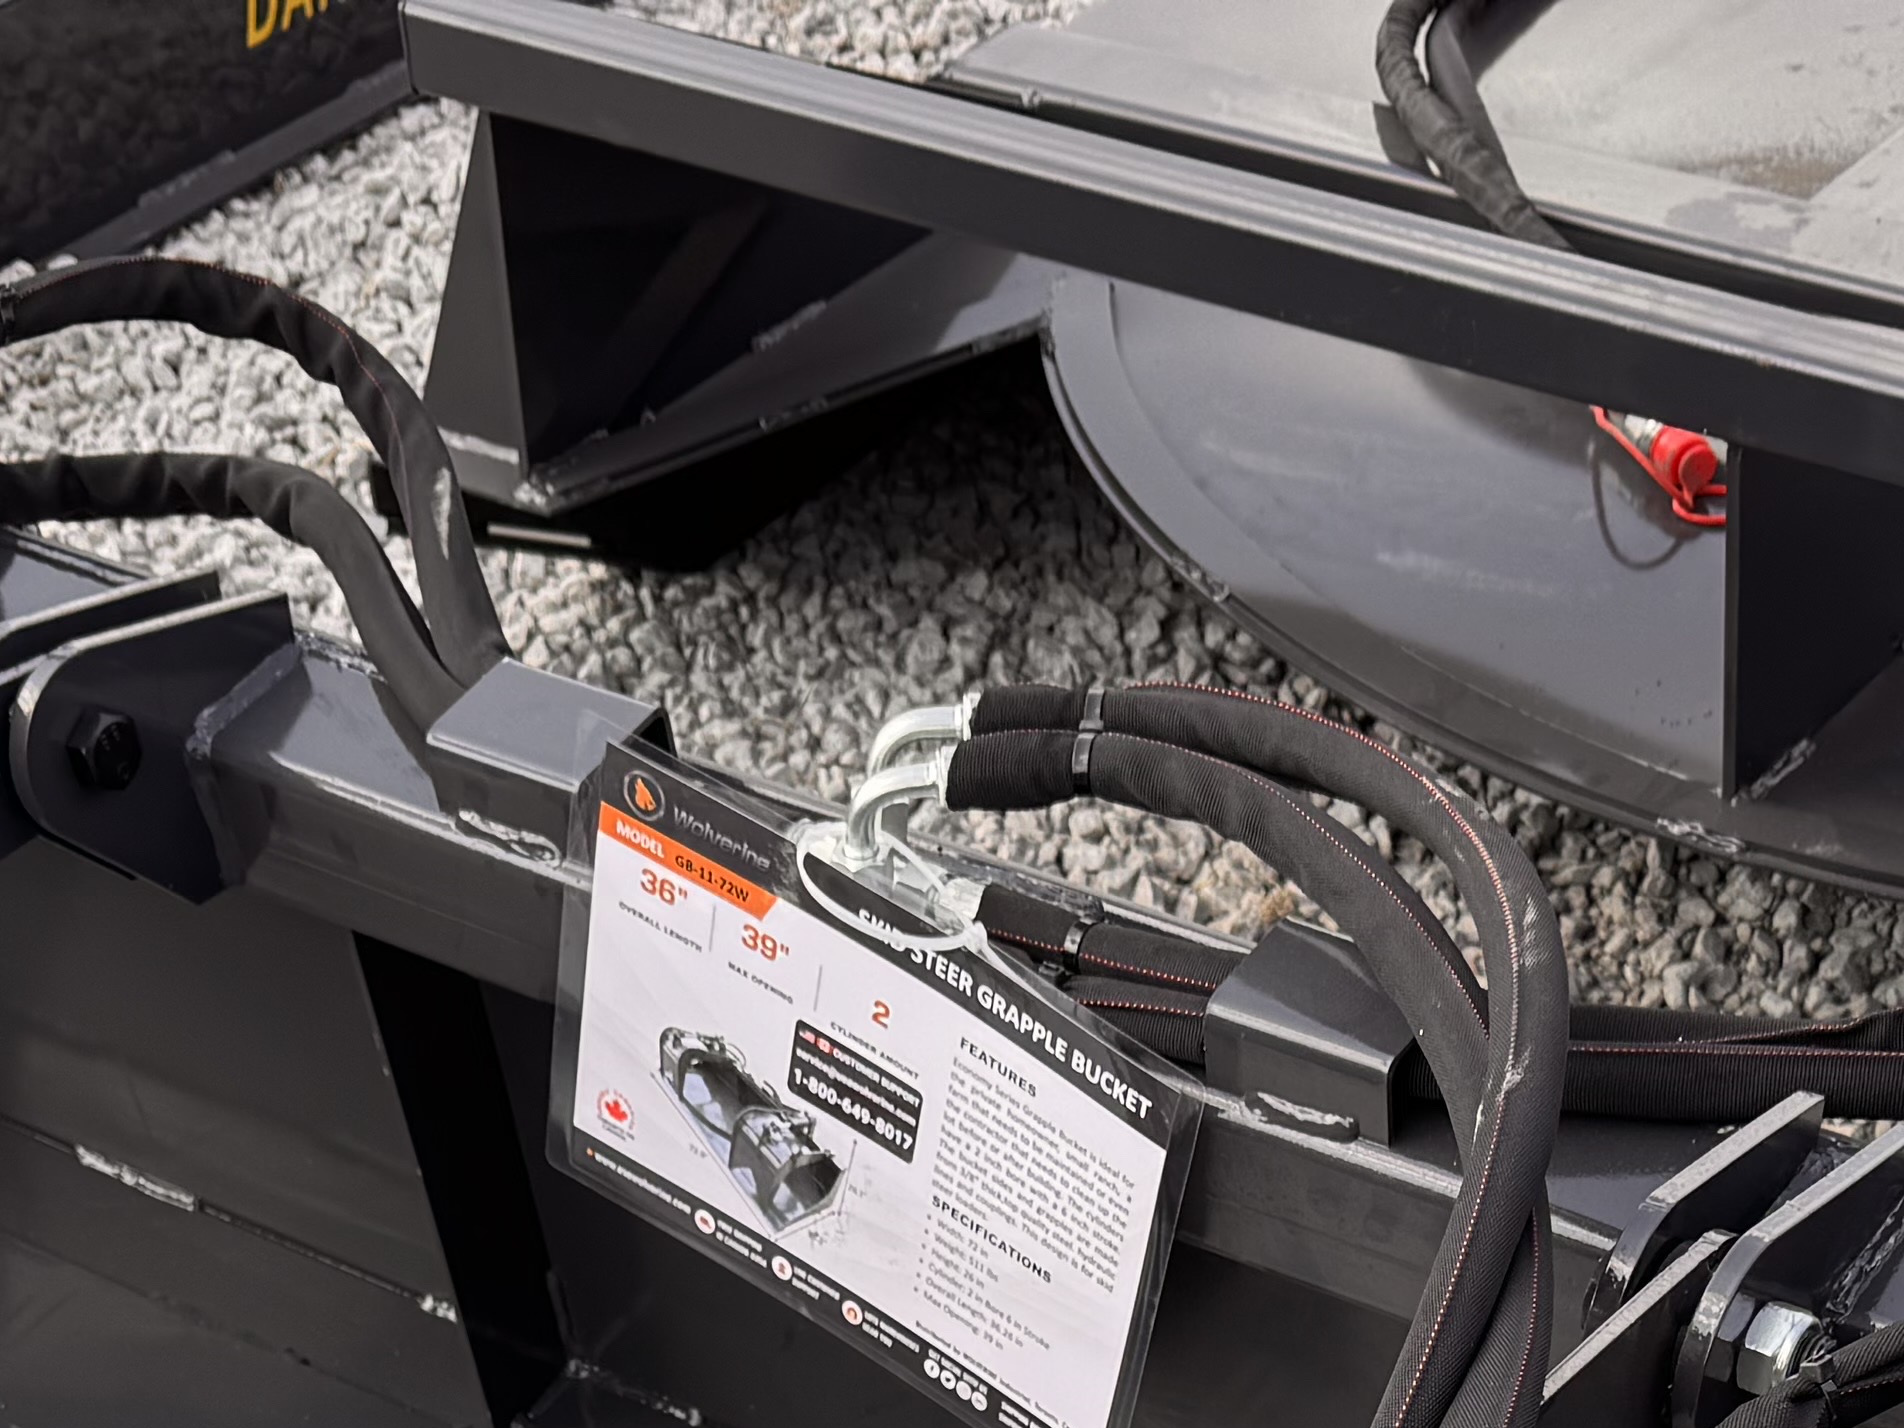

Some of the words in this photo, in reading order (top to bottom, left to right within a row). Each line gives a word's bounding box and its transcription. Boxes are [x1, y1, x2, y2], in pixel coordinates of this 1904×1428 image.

[616, 819, 665, 859] MODEL
[673, 804, 771, 870] Wolverine
[640, 868, 688, 906] 36"
[742, 923, 789, 961] 39"
[872, 1000, 890, 1029] 2
[911, 948, 973, 997] STEER
[977, 984, 1068, 1062] GRAPPLE
[1072, 1049, 1153, 1120] BUCKET
[960, 1036, 1037, 1098] FEATURES
[793, 1066, 912, 1152] 1-800-649-8017
[932, 1194, 1052, 1284] SPECIFICATIONS
